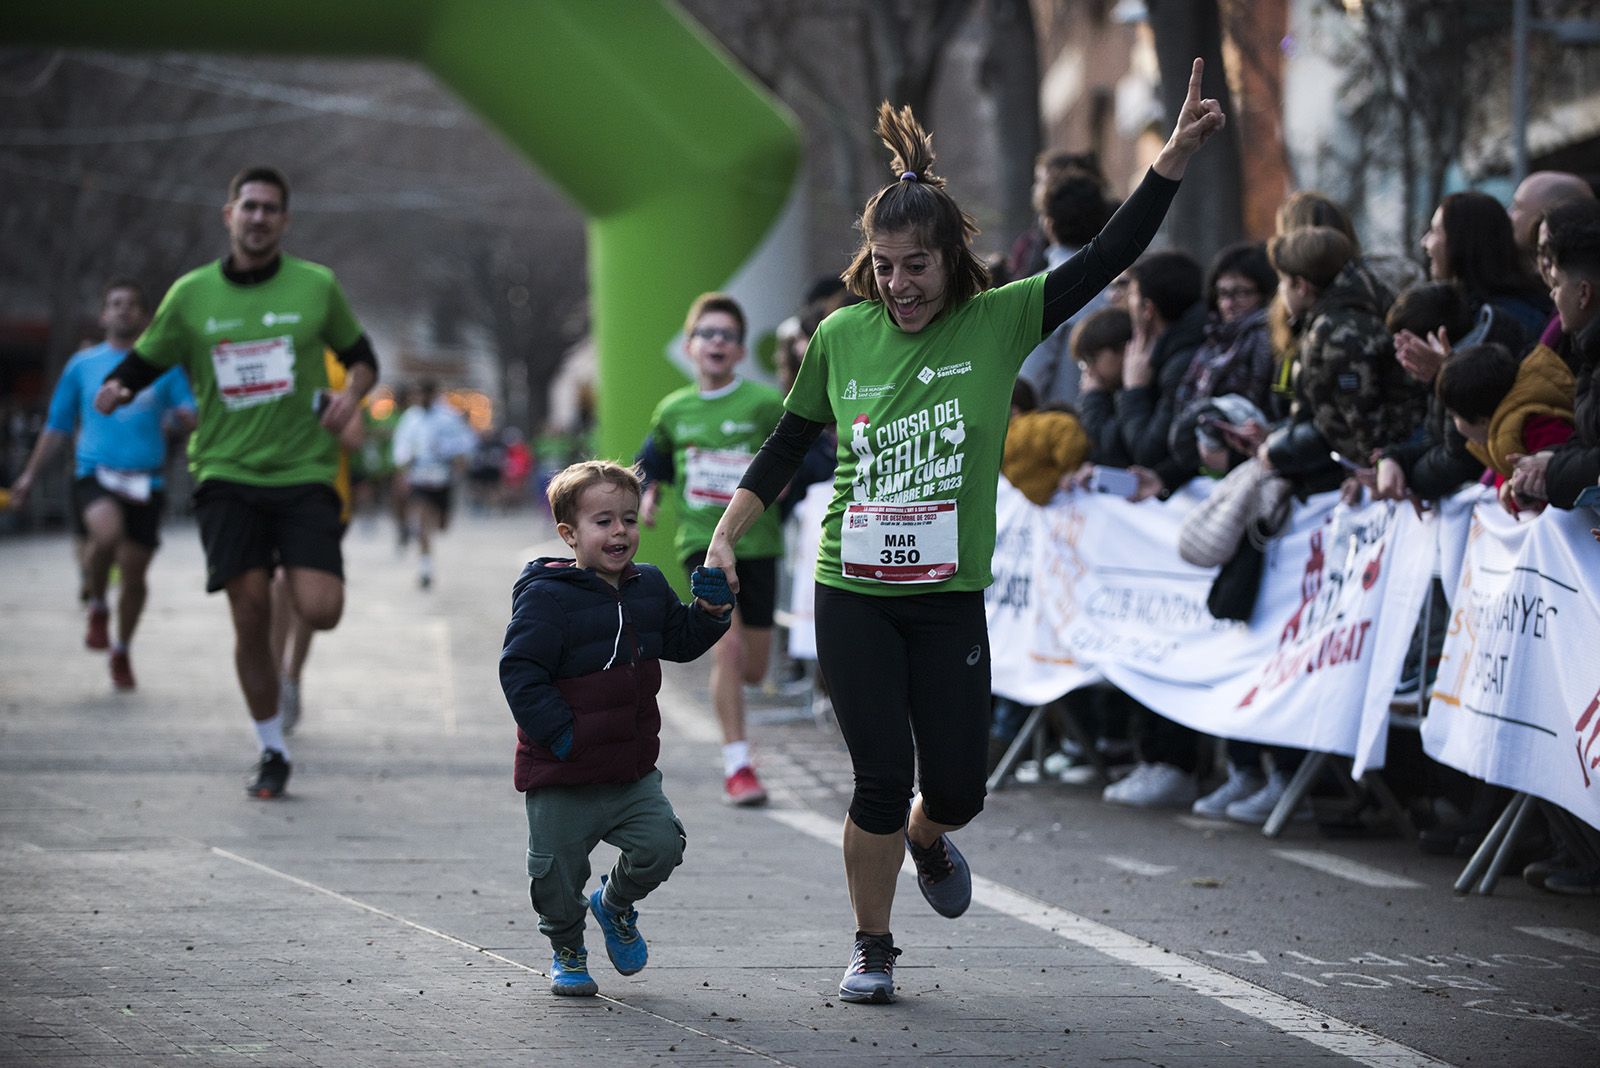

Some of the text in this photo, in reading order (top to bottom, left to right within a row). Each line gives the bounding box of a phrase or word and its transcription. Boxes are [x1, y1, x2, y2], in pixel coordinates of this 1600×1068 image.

[936, 365, 972, 378] SantCugat
[876, 398, 963, 449] CURSA DEL
[876, 431, 940, 476] GALL
[875, 453, 965, 498] SANT CUGAT
[922, 483, 936, 498] DE
[937, 475, 963, 493] 2023
[885, 534, 916, 547] MAR
[879, 549, 920, 564] 350
